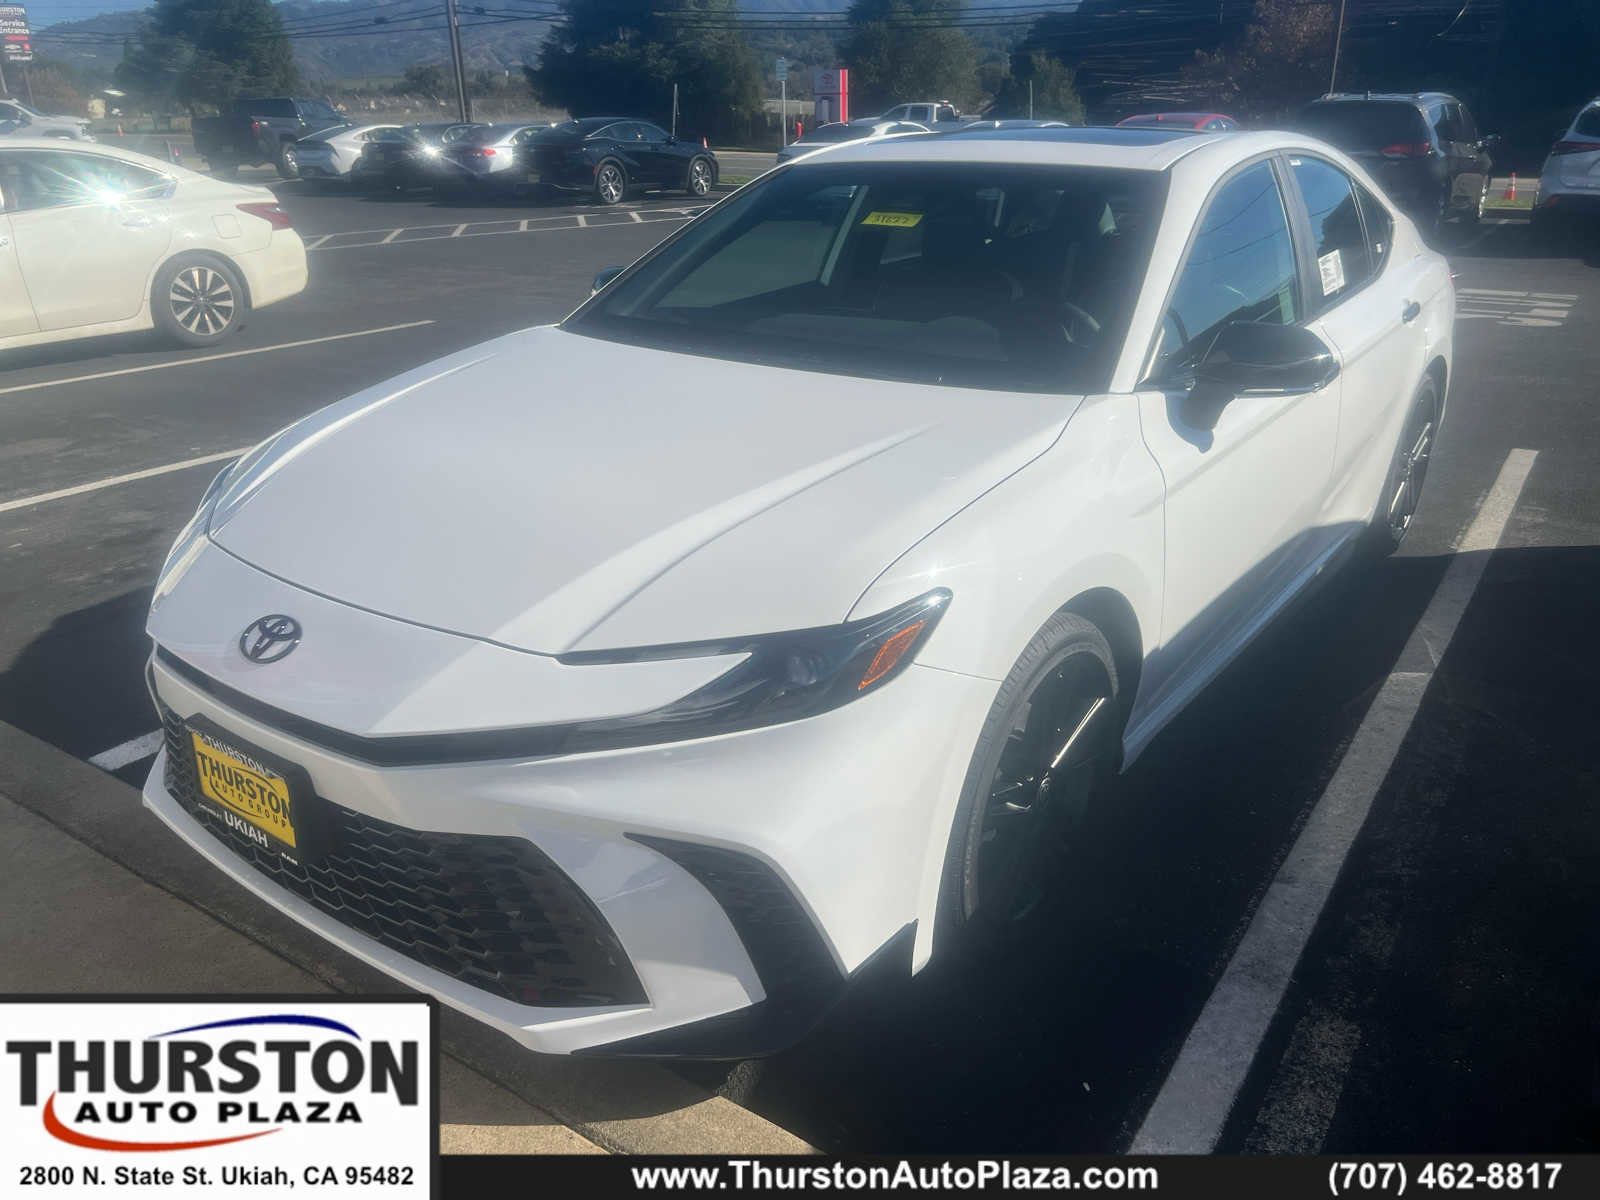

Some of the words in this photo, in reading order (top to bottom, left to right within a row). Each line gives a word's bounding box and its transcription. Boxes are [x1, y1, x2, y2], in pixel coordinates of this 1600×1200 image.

[205, 735, 265, 774] THURSTON
[197, 751, 289, 819] THURSTON
[214, 779, 244, 802] AUTO
[248, 799, 286, 827] GROUP
[224, 811, 269, 848] UKIAH
